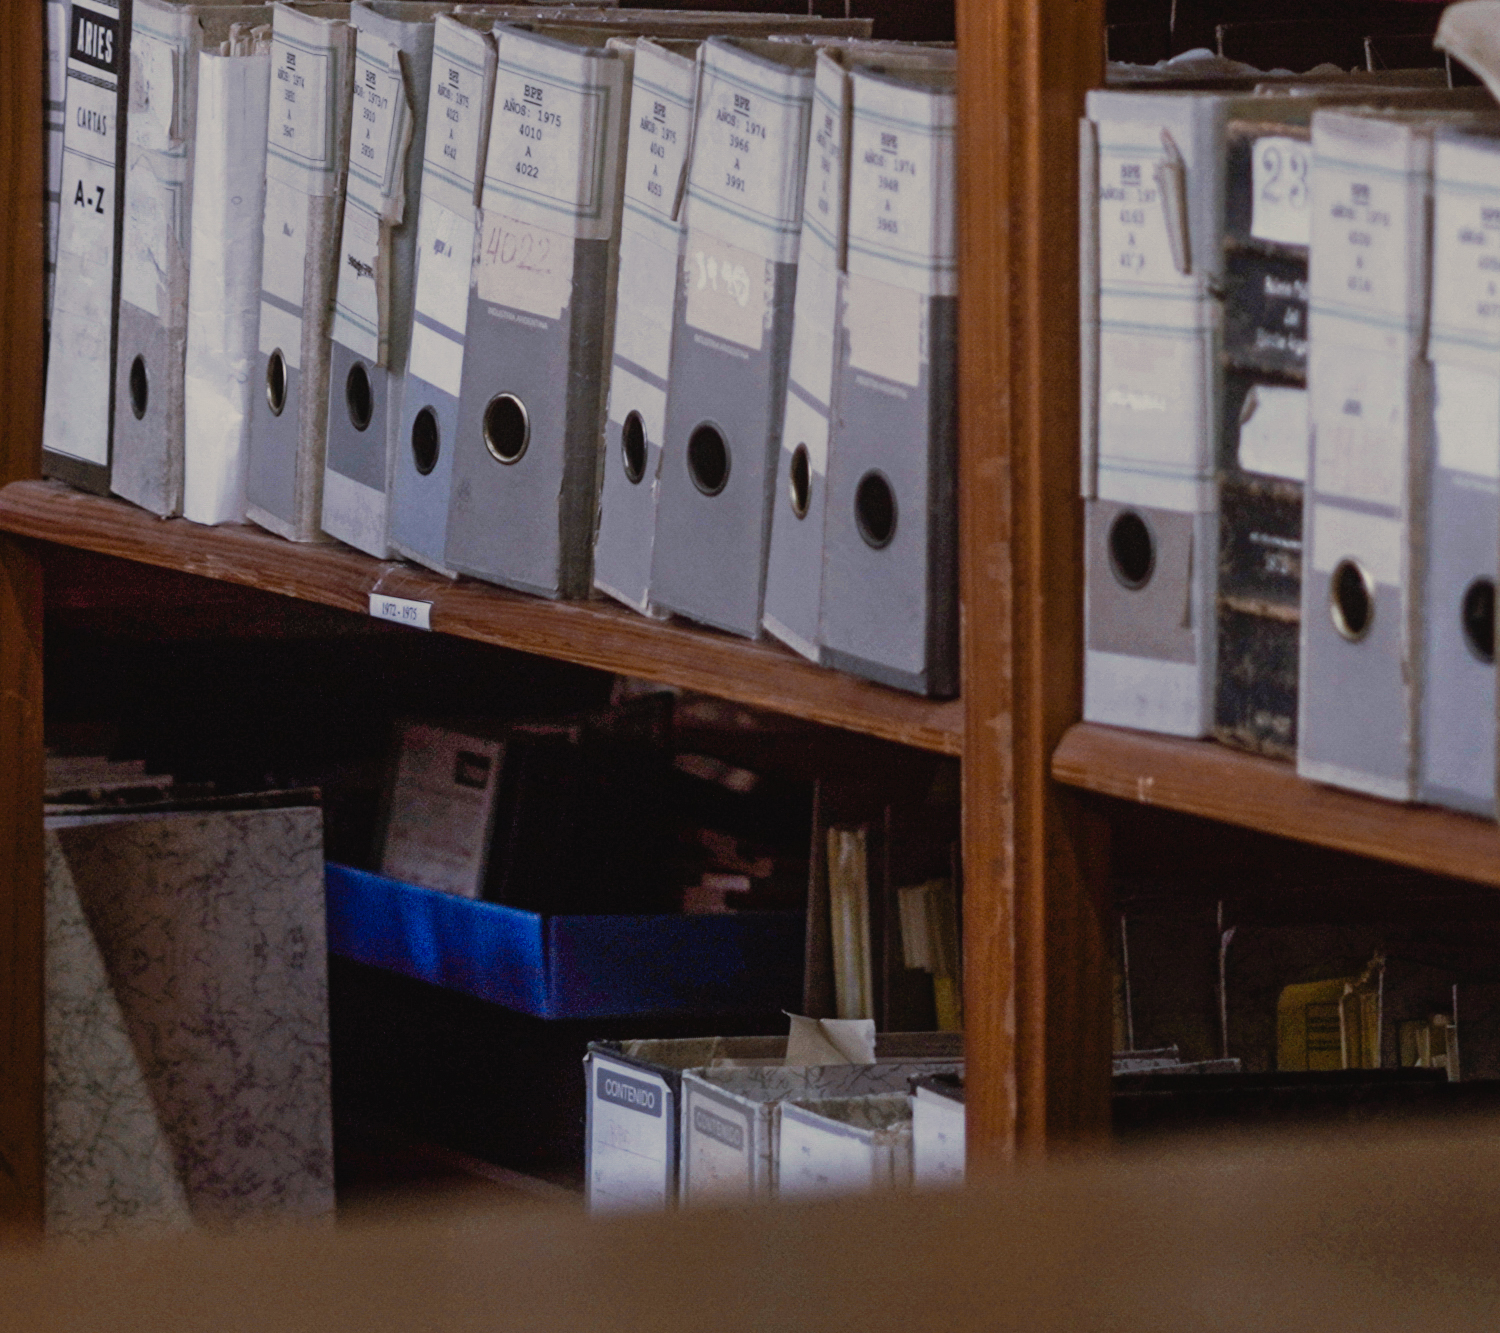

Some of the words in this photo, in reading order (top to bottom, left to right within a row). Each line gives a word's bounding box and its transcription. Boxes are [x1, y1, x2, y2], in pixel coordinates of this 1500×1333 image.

[77, 17, 113, 64] ARIES
[456, 92, 470, 109] 1975
[524, 84, 543, 101] BPE
[653, 101, 666, 118] BPE
[734, 94, 750, 112] BPE
[77, 106, 107, 136] CARTAS
[503, 98, 530, 118] AÑOS:
[538, 110, 562, 127] 1975
[519, 124, 542, 141] 4010
[661, 127, 677, 144] 1975
[745, 120, 766, 139] 1974
[525, 146, 532, 158] A
[729, 134, 749, 153] 3966
[515, 162, 539, 179] 4022
[734, 158, 740, 170] A
[726, 173, 745, 192] 3991
[382, 602, 397, 617] 1972
[604, 1077, 656, 1110] CONTENIDO
